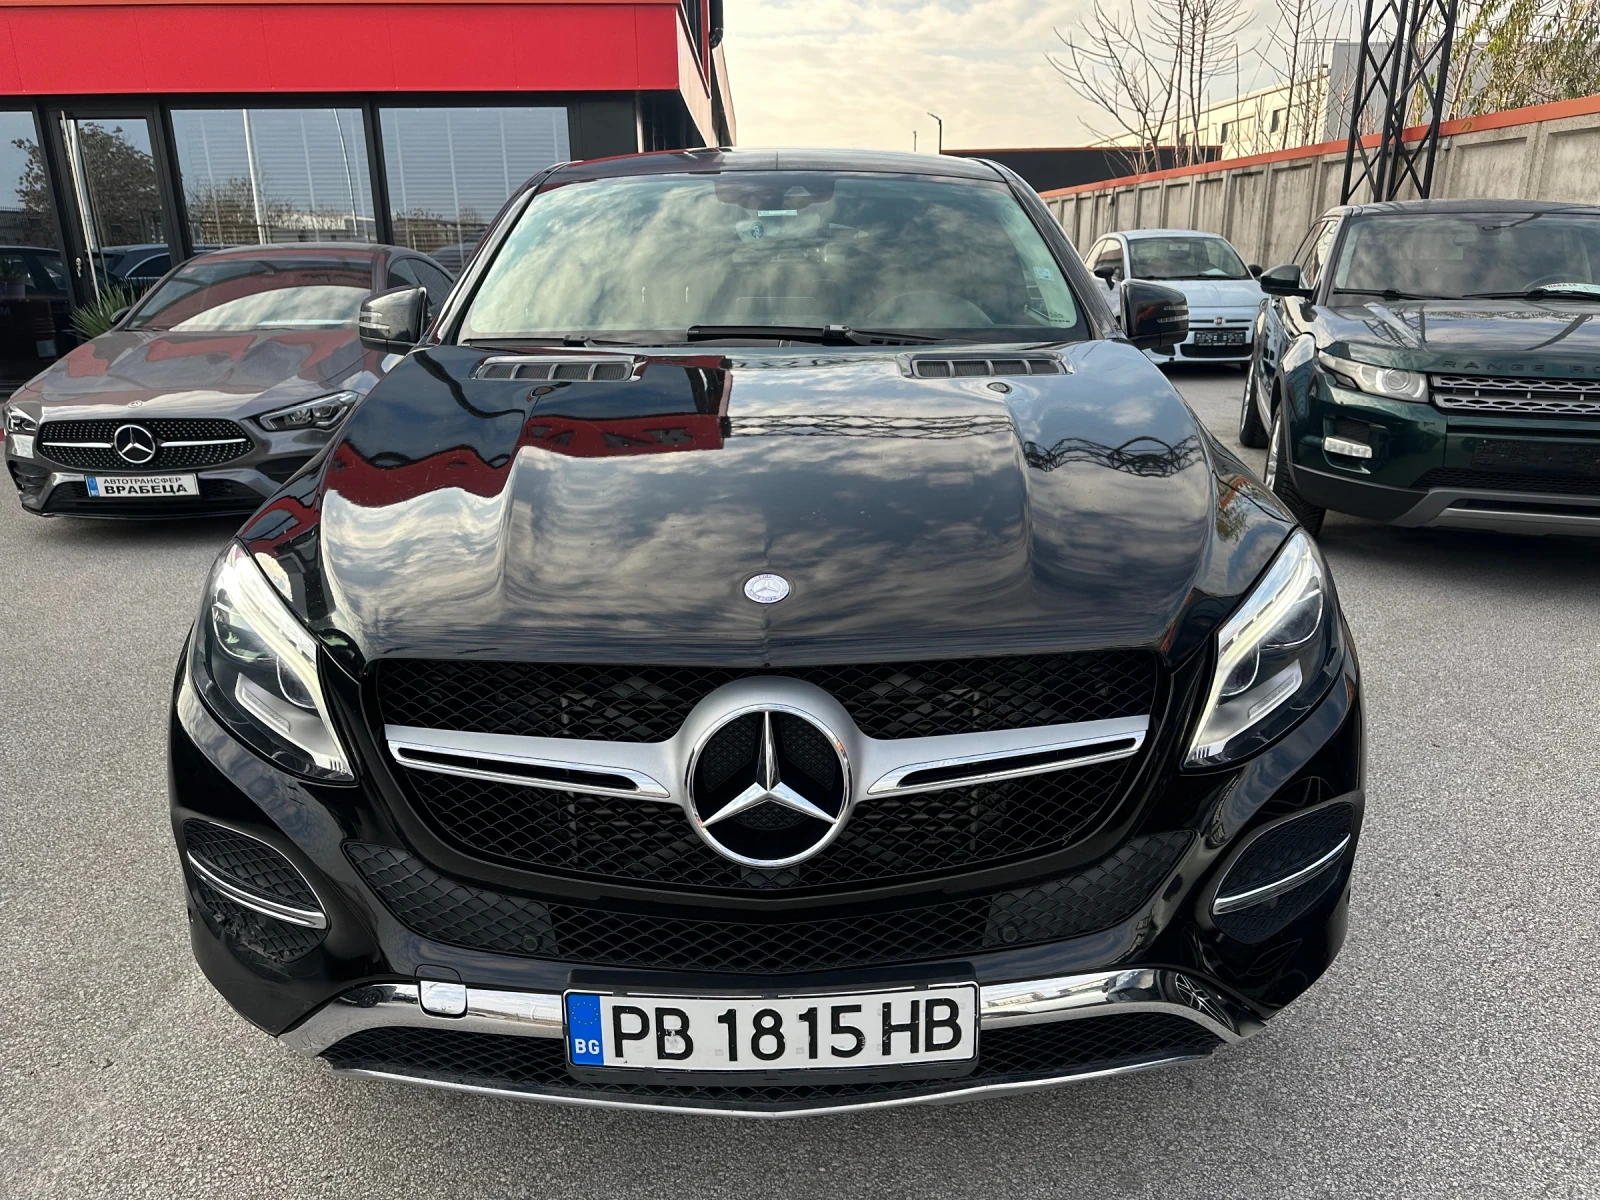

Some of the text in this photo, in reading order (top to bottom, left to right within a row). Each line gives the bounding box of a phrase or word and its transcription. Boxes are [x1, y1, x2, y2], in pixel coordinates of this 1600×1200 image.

[1441, 360, 1546, 373] RANGE
[103, 477, 182, 485] АВТОТРАНСФЕР
[104, 484, 188, 495] ВРАБЕЦА
[611, 997, 962, 1062] PB 1815 HB
[574, 1038, 600, 1055] BG
